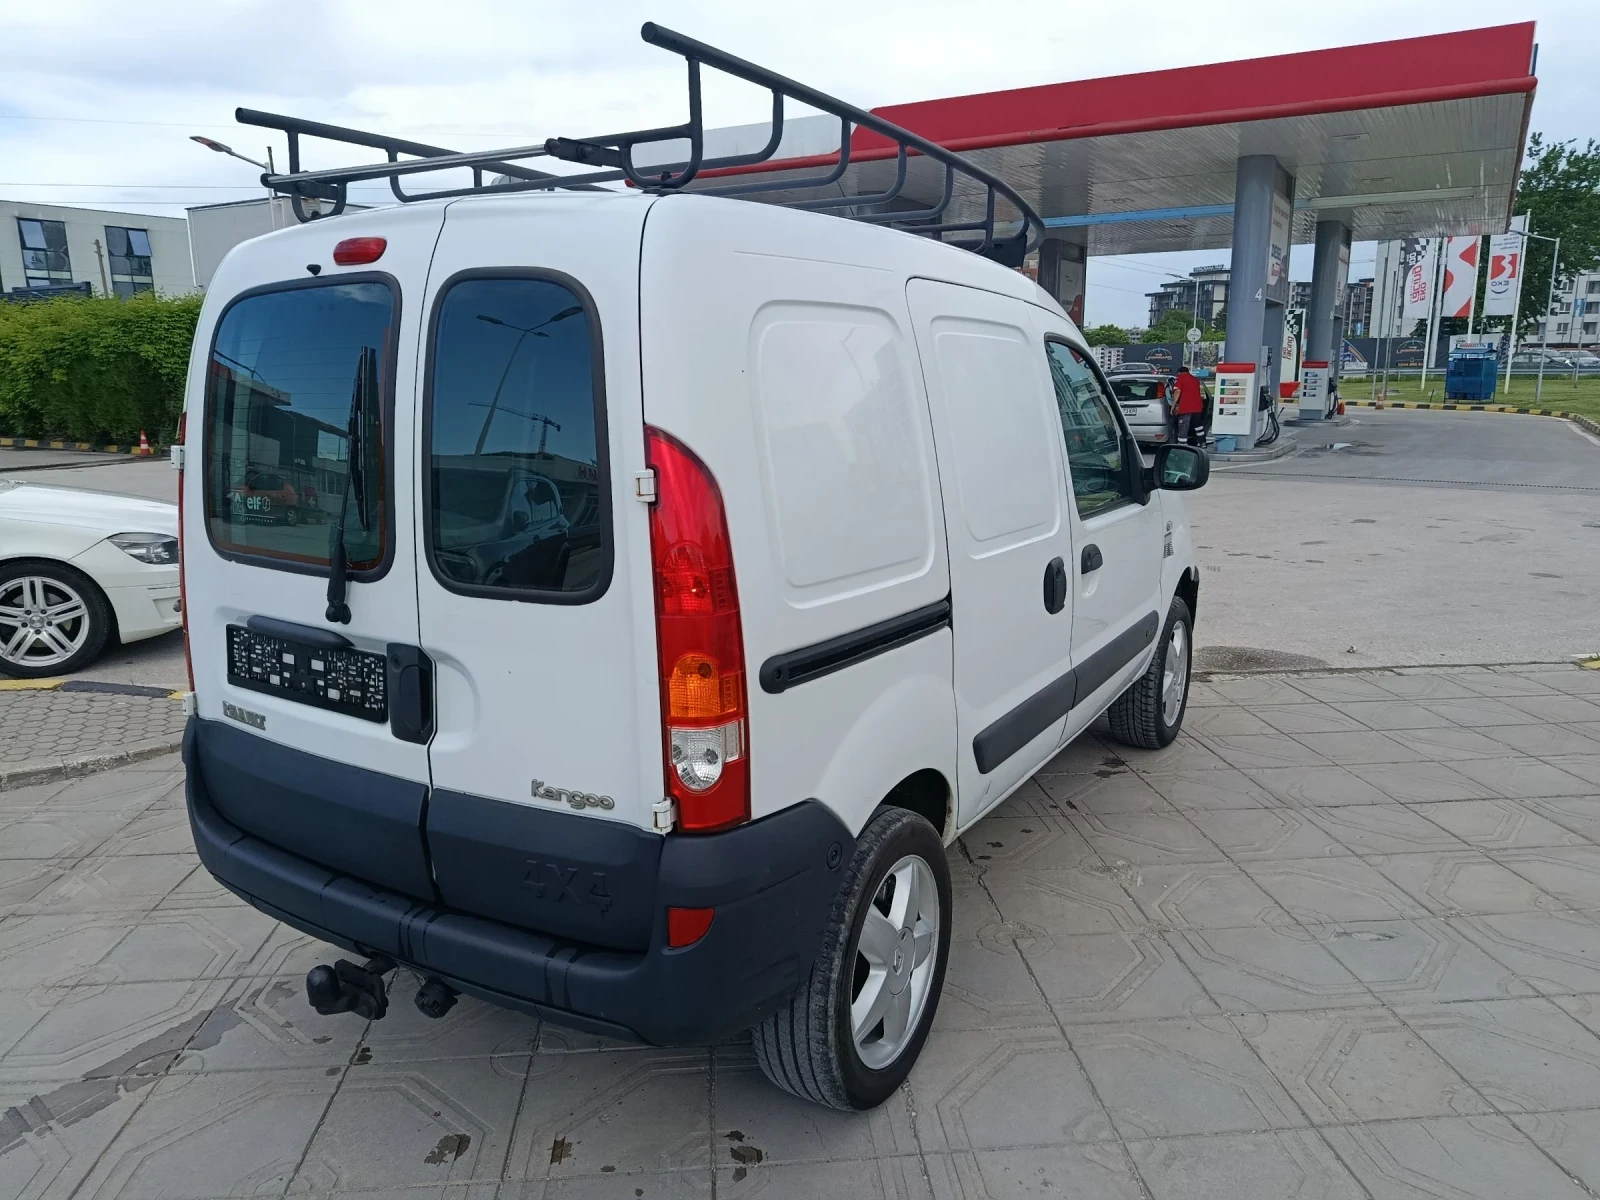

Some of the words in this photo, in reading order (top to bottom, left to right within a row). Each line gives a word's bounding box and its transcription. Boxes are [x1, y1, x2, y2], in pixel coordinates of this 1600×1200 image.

[1254, 288, 1262, 301] 4
[1286, 336, 1295, 360] racing
[246, 496, 262, 510] elf
[530, 779, 615, 810] Kangoo
